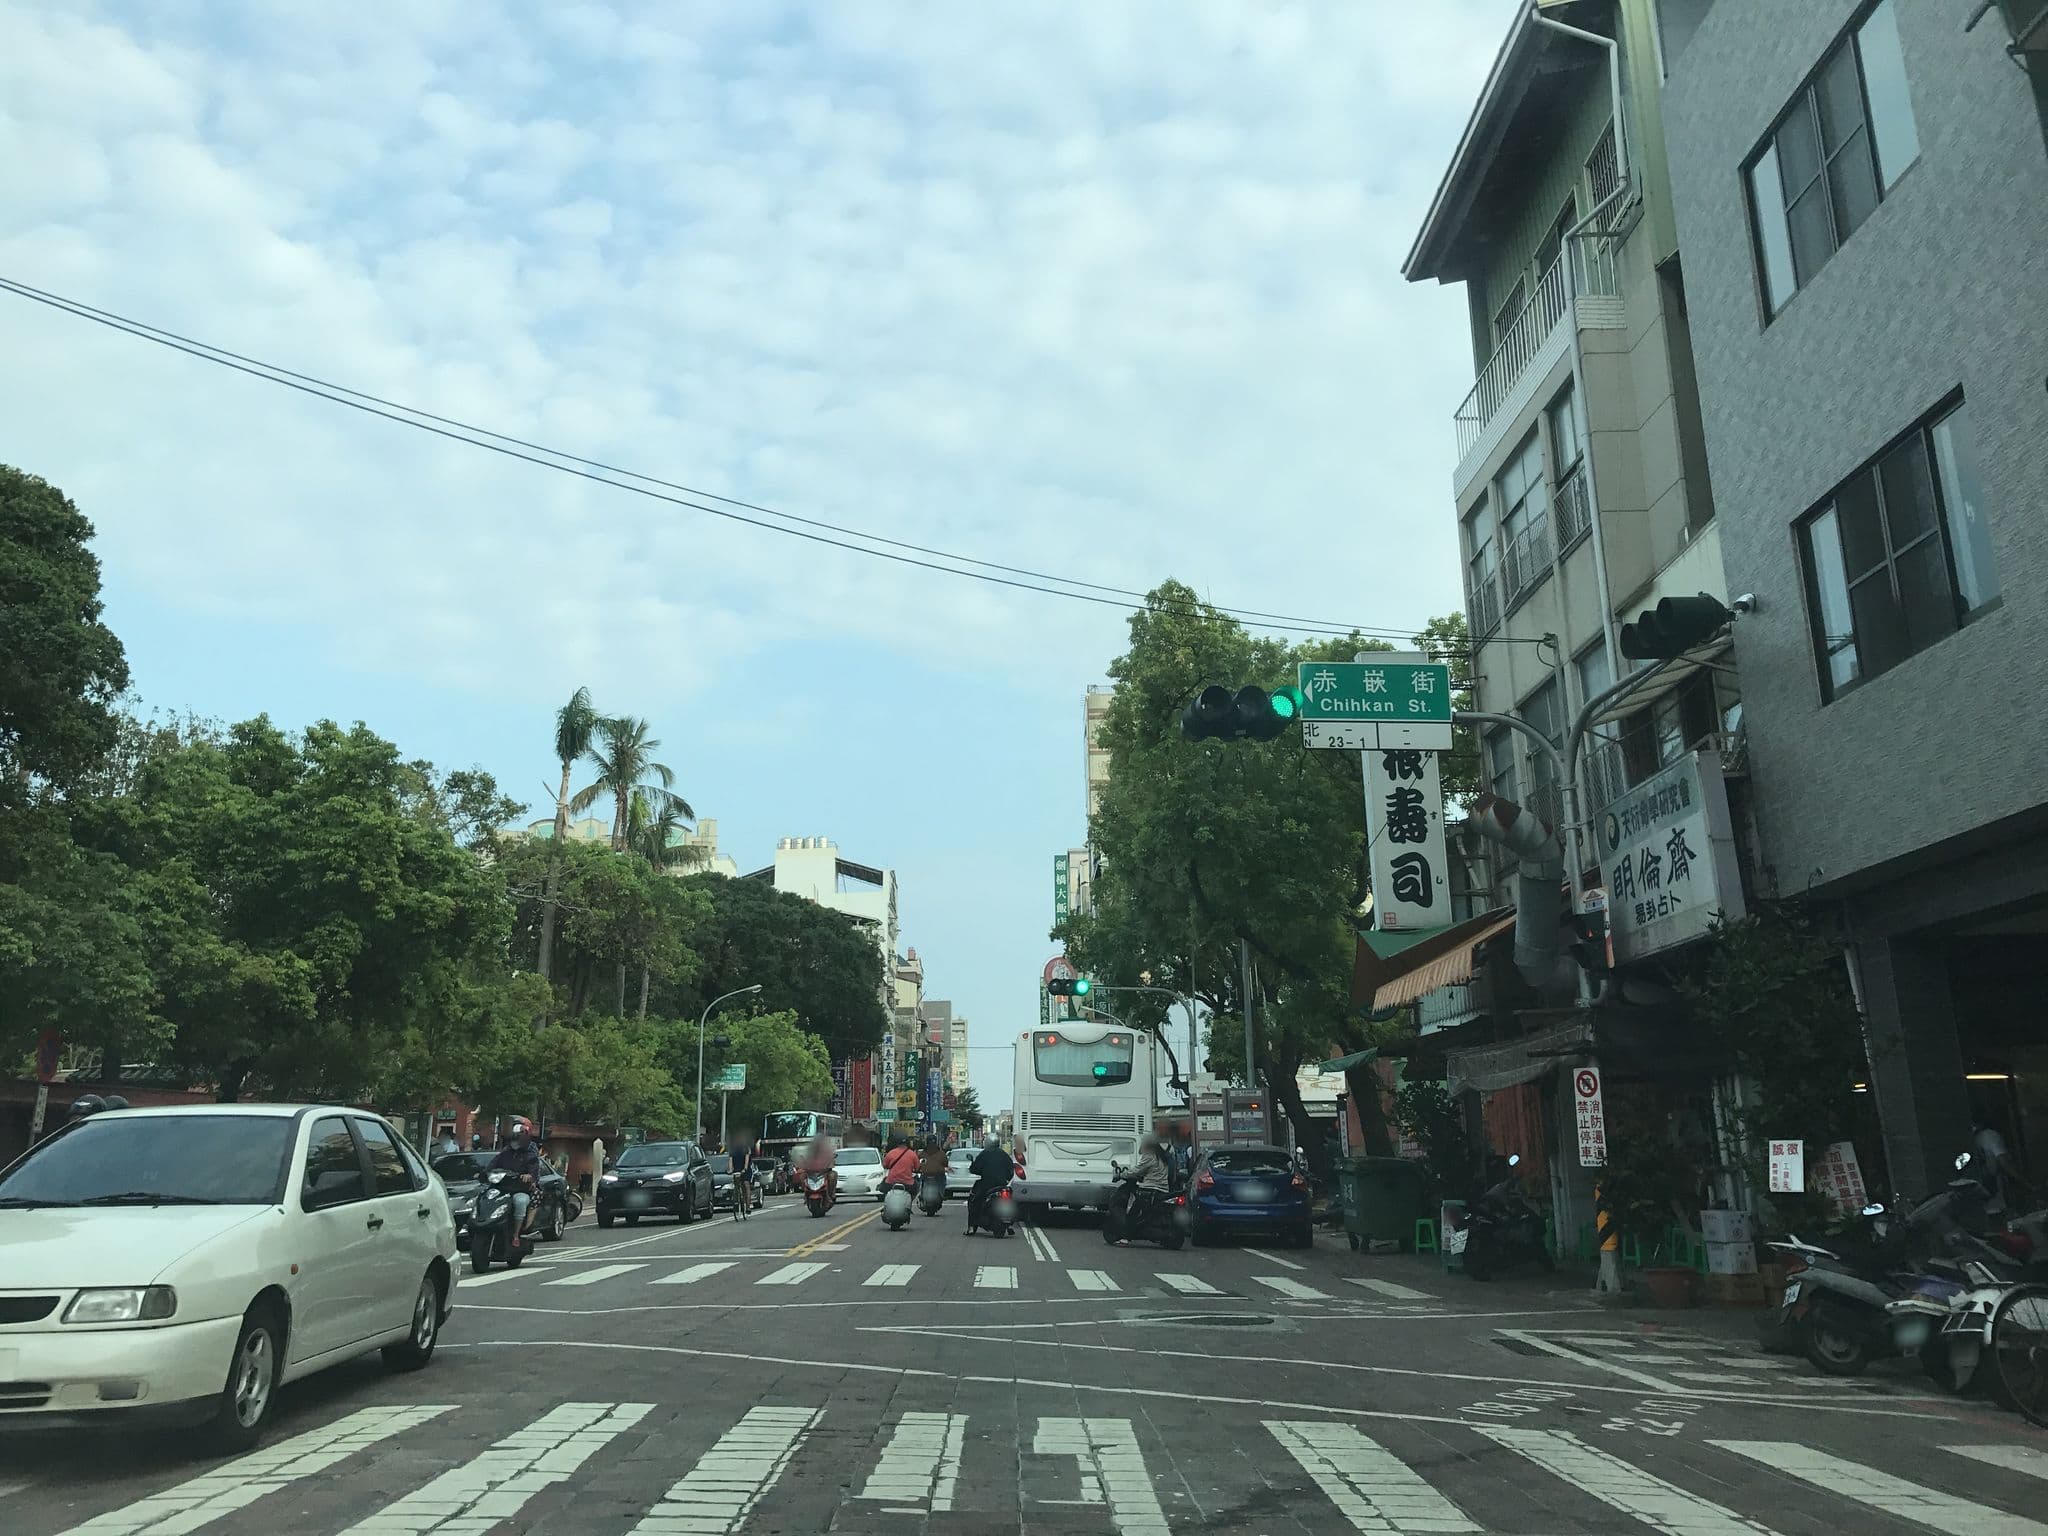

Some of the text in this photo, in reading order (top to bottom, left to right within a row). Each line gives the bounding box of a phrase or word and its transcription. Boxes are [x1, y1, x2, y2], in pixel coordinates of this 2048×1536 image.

[1313, 669, 1436, 694] 赤嵌街
[1320, 698, 1432, 713] Chihkan St.
[1304, 723, 1320, 737] 北
[1613, 827, 1697, 901] 明倫齋
[1577, 1101, 1593, 1159] 禁止停車
